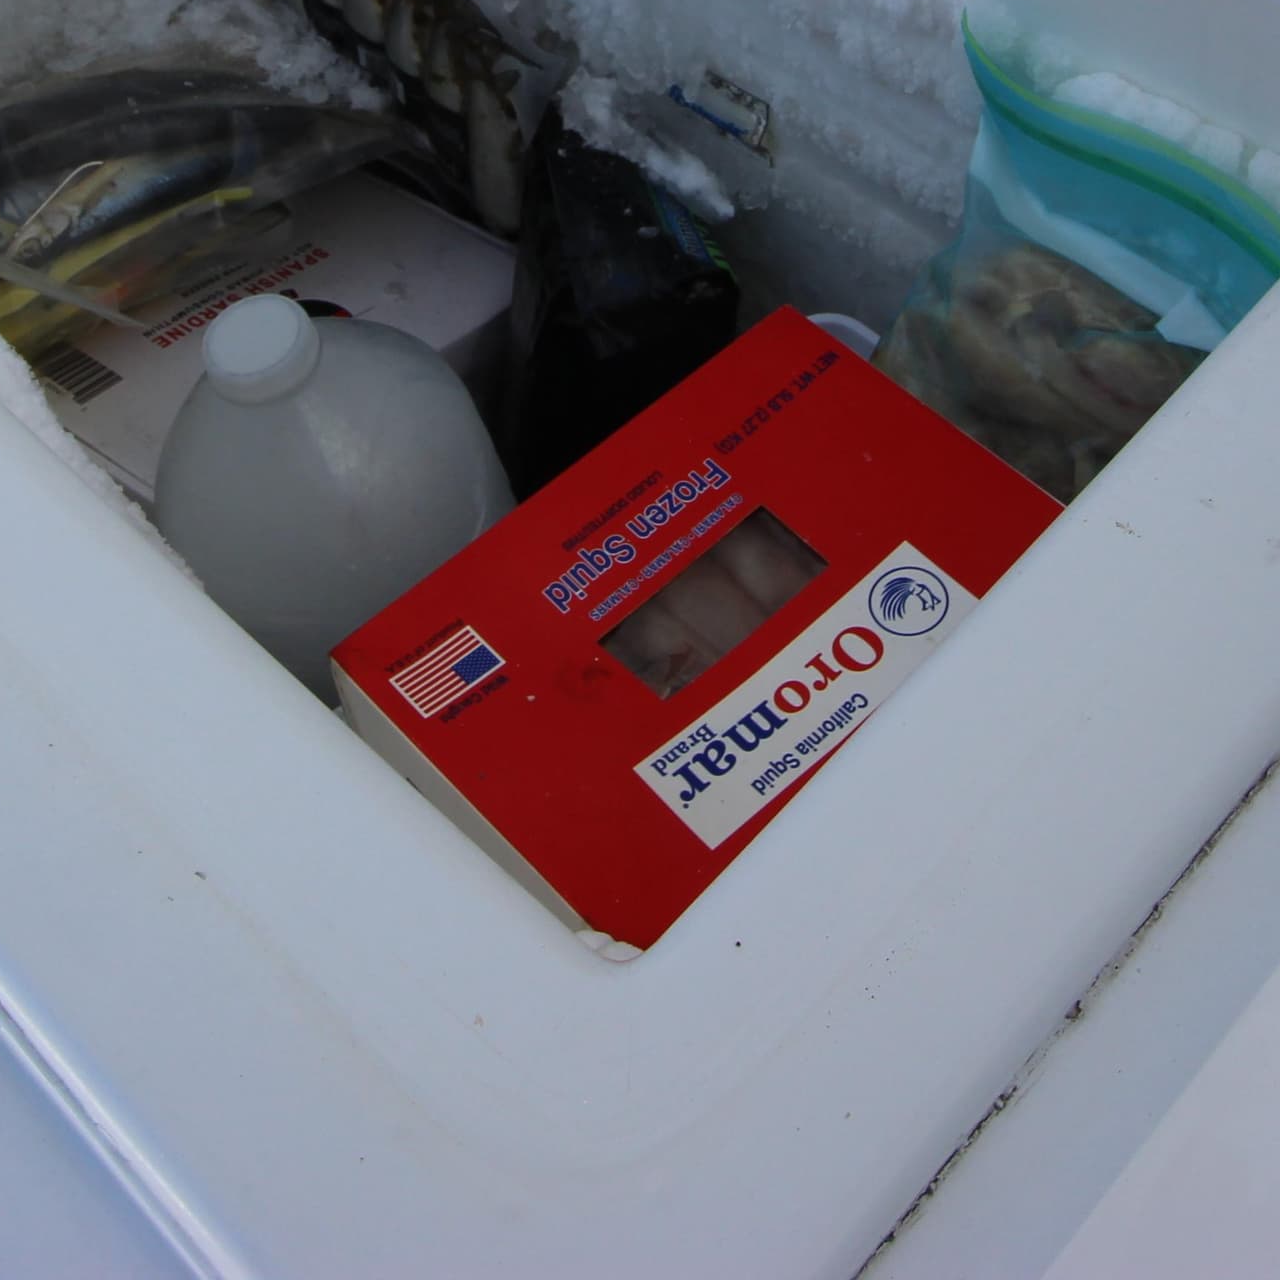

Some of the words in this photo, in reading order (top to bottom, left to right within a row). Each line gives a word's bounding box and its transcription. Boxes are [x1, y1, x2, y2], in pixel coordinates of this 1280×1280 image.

[244, 245, 330, 296] SPANISH
[150, 292, 242, 350] SARDINE
[811, 347, 841, 375] NET
[713, 429, 745, 456] KG)
[624, 455, 729, 541] Frozen
[691, 491, 744, 537] CALAMARI
[541, 530, 636, 614] Squid
[639, 535, 690, 578] CALAMAR
[588, 575, 639, 622] CALMARS
[669, 626, 884, 806] Oromar
[793, 690, 869, 760] California
[650, 721, 714, 777] Brand
[749, 751, 800, 796] Squid
